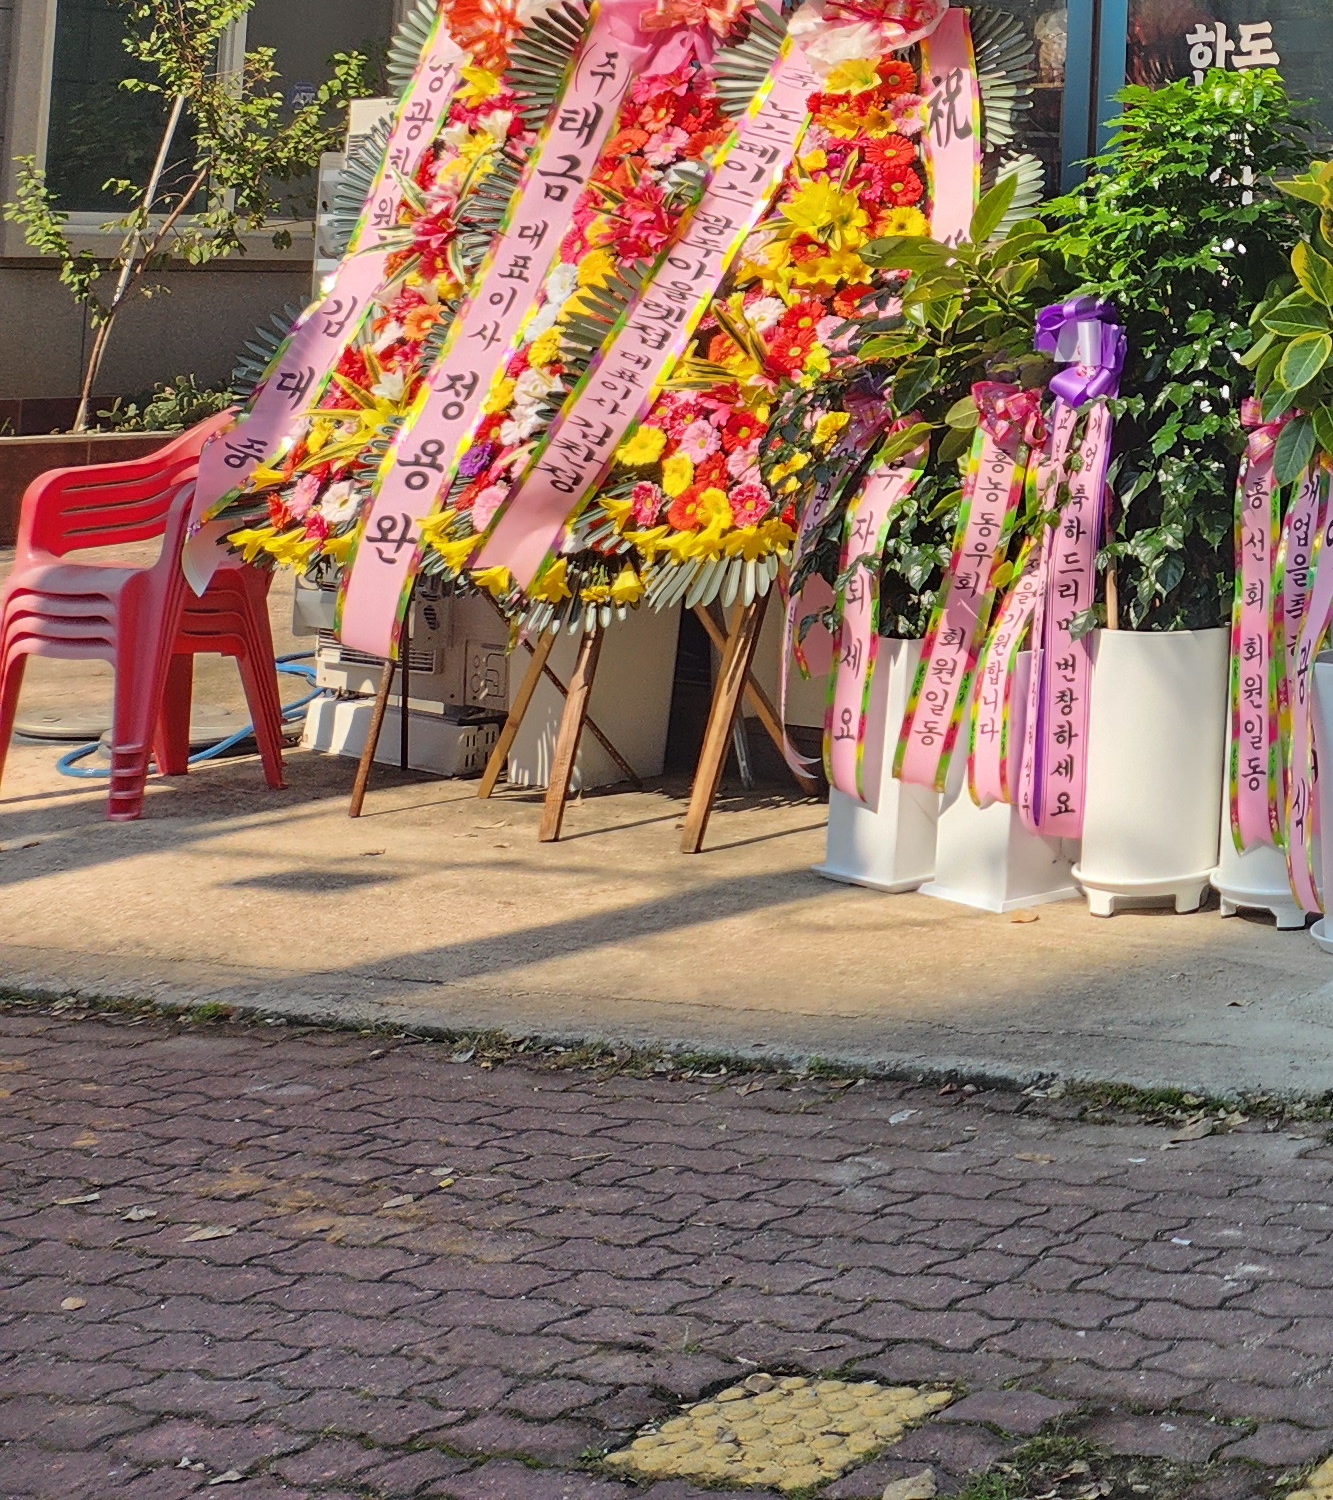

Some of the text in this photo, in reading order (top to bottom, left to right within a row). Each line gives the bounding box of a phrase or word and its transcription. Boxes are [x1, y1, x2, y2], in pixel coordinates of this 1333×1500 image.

[928, 67, 973, 148] 祝
[467, 218, 550, 351] 대표이사
[366, 370, 480, 565] 정용완
[914, 627, 966, 747] 회원일동
[1048, 652, 1081, 818] 번창하세요
[1242, 633, 1267, 792] 회원일동
